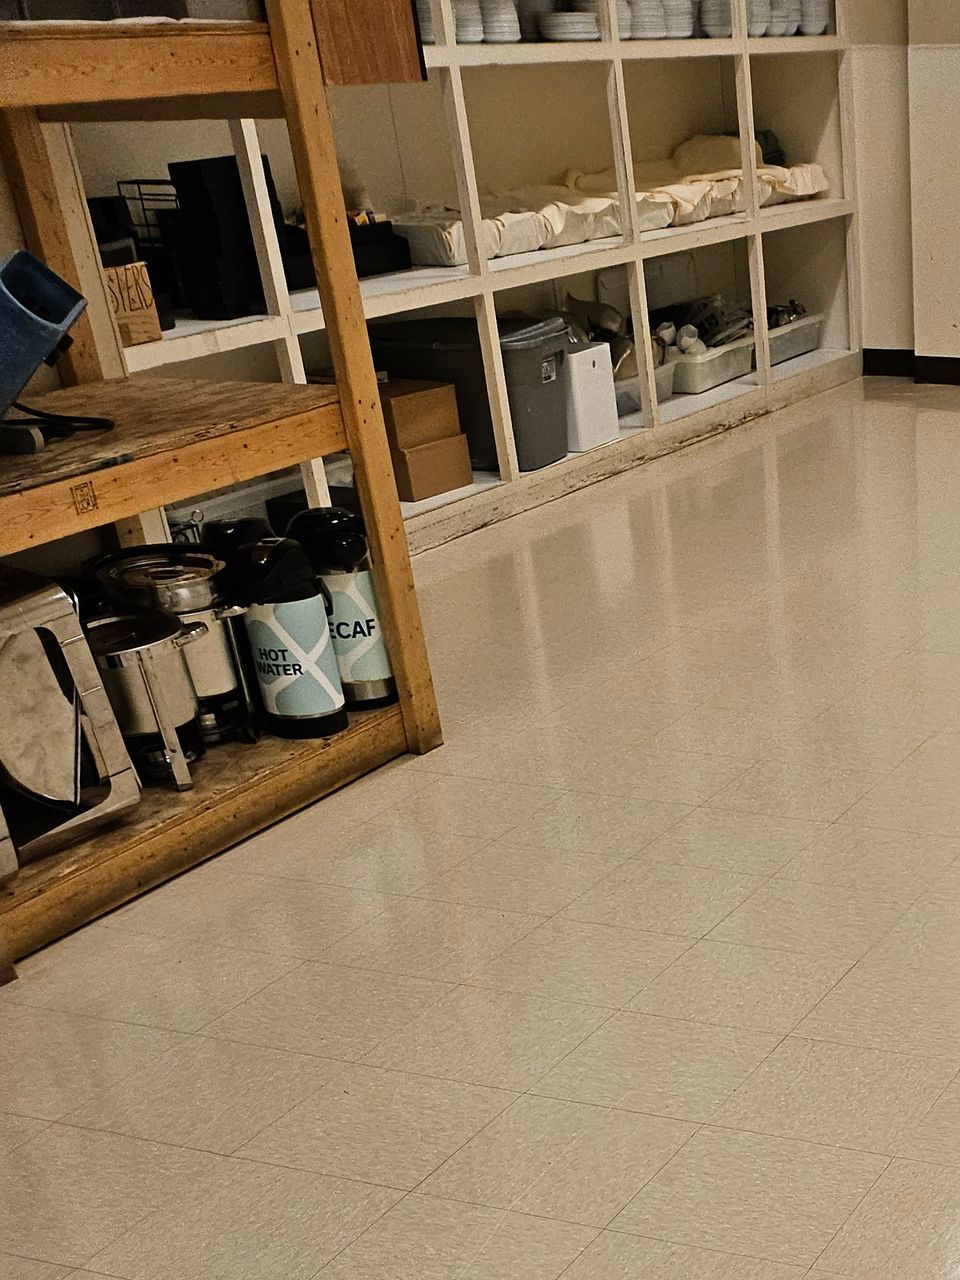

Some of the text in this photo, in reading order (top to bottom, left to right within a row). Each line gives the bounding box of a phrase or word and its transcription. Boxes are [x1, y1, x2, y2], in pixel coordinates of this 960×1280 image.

[328, 618, 376, 639] ECAF
[258, 647, 288, 661] HOT
[256, 662, 304, 676] WATER
